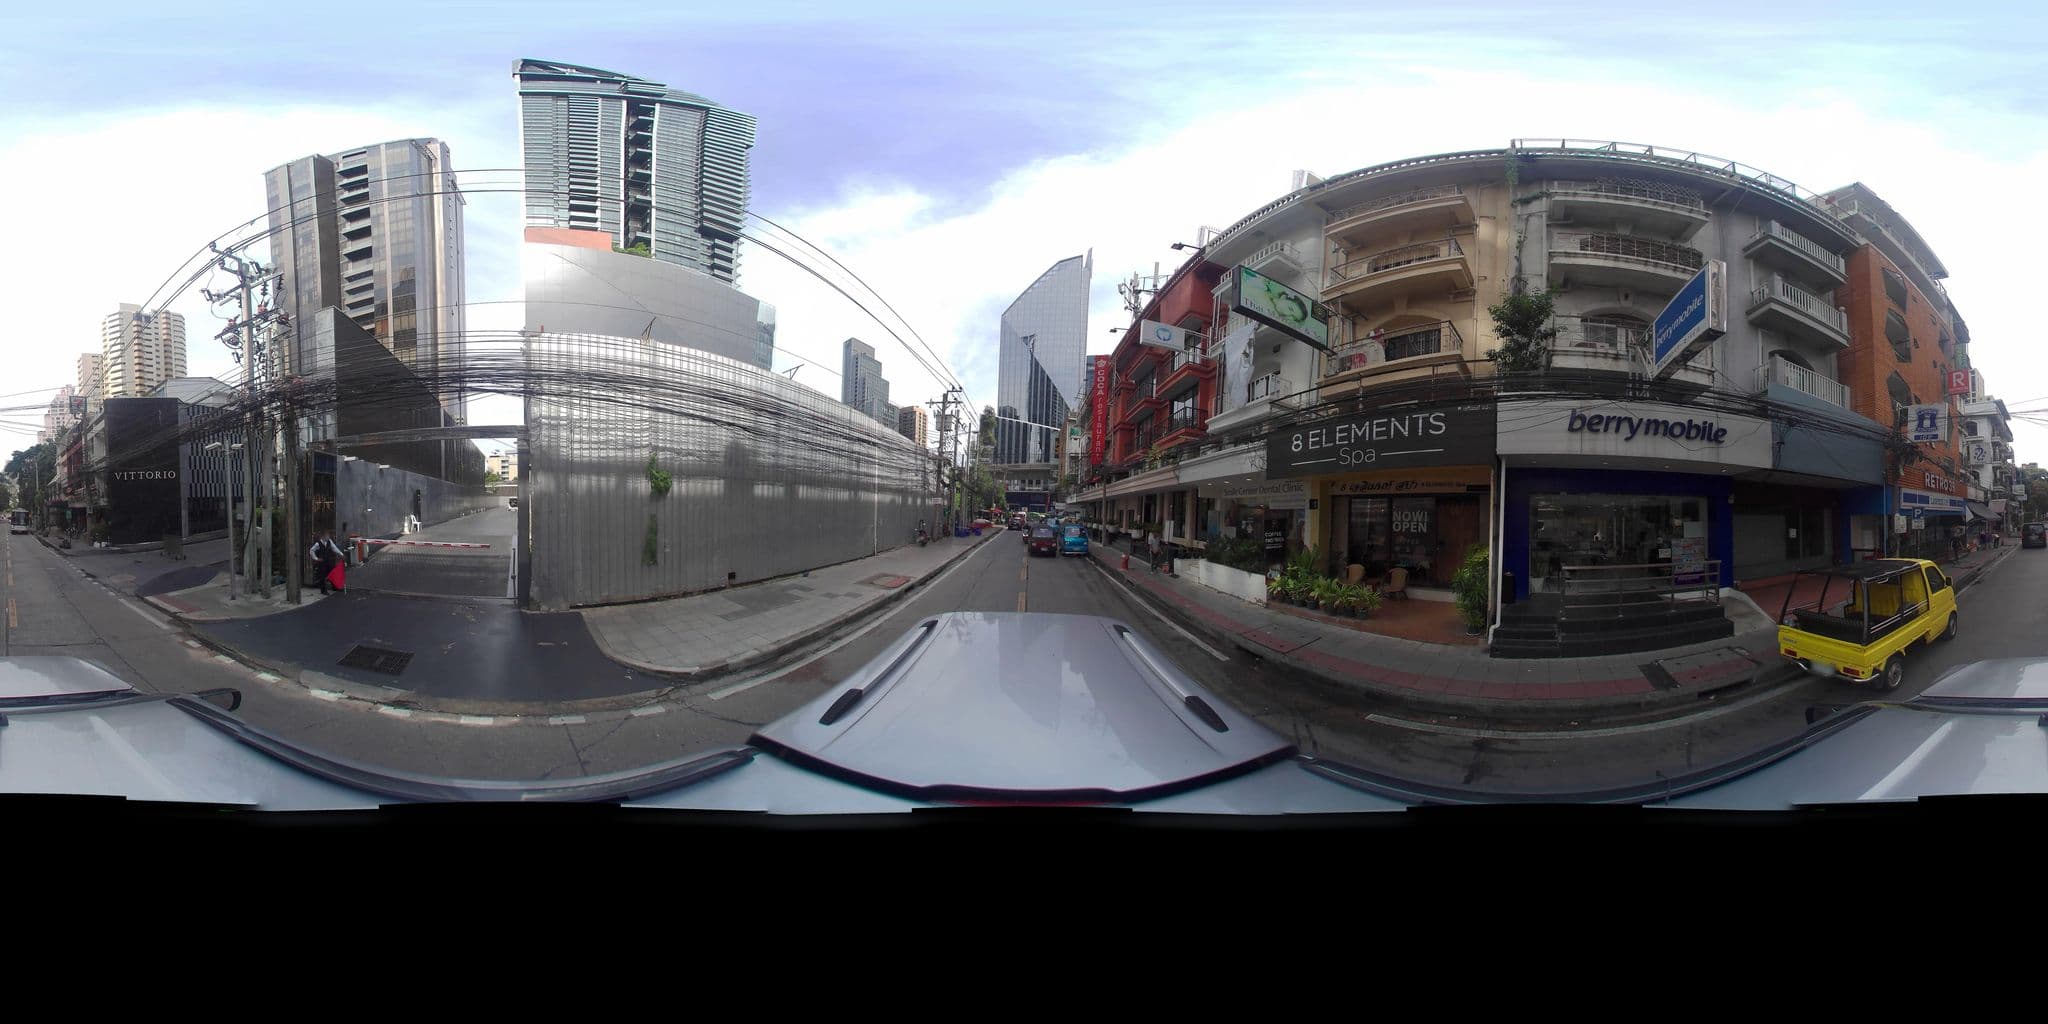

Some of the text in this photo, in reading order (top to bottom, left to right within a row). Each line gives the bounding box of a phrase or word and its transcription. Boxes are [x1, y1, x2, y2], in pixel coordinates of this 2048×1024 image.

[1952, 371, 1965, 387] R
[1095, 369, 1105, 460] COCA restaurant
[1291, 412, 1447, 452] 8 ELEMENTS
[1338, 447, 1376, 467] Spa
[114, 470, 176, 480] VITTORIO
[1282, 480, 1304, 493] Clinic
[1914, 508, 1922, 518] P
[1392, 521, 1428, 533] OPEN
